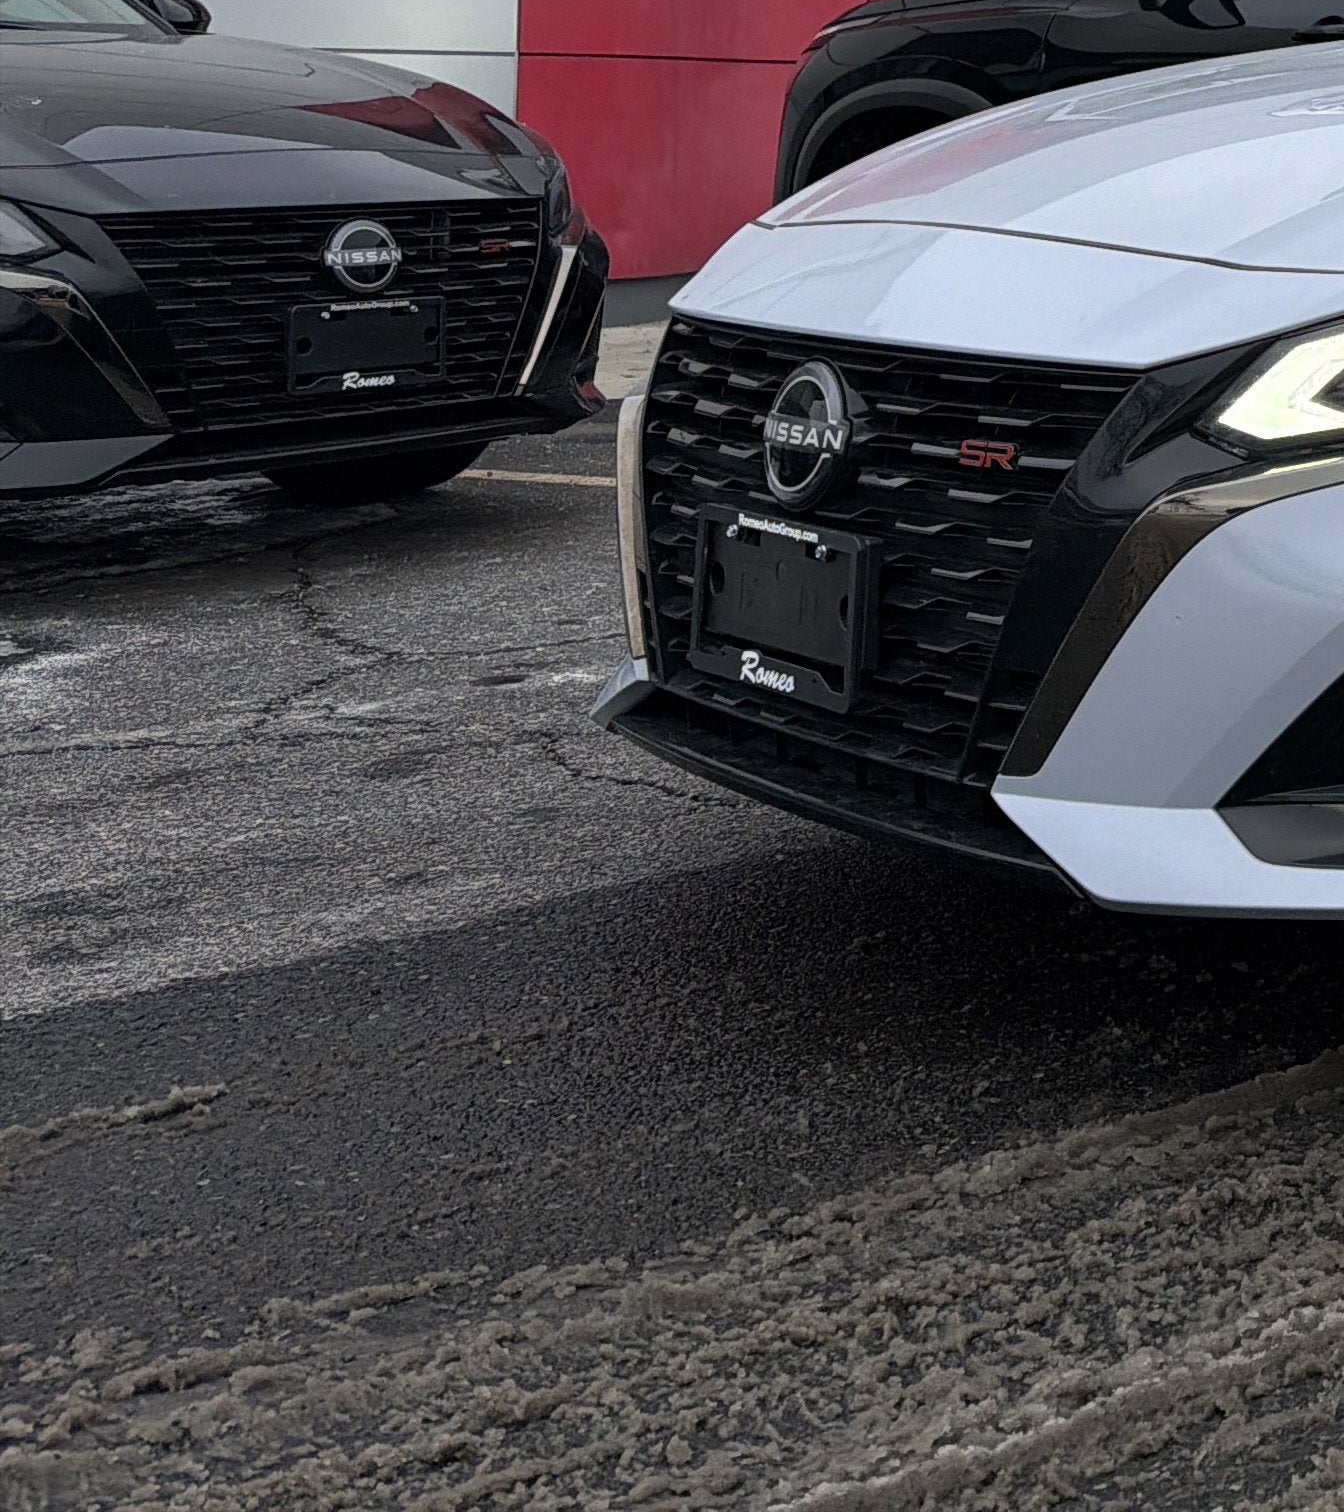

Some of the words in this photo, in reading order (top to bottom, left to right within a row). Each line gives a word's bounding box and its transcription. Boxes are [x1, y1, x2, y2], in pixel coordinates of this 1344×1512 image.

[327, 248, 402, 265] NISSAN
[341, 371, 396, 391] Romeo
[764, 418, 844, 450] NISSAN
[958, 439, 1017, 471] SR
[738, 512, 819, 544] RomeoAutoGroup.com
[740, 650, 795, 693] Romeo
